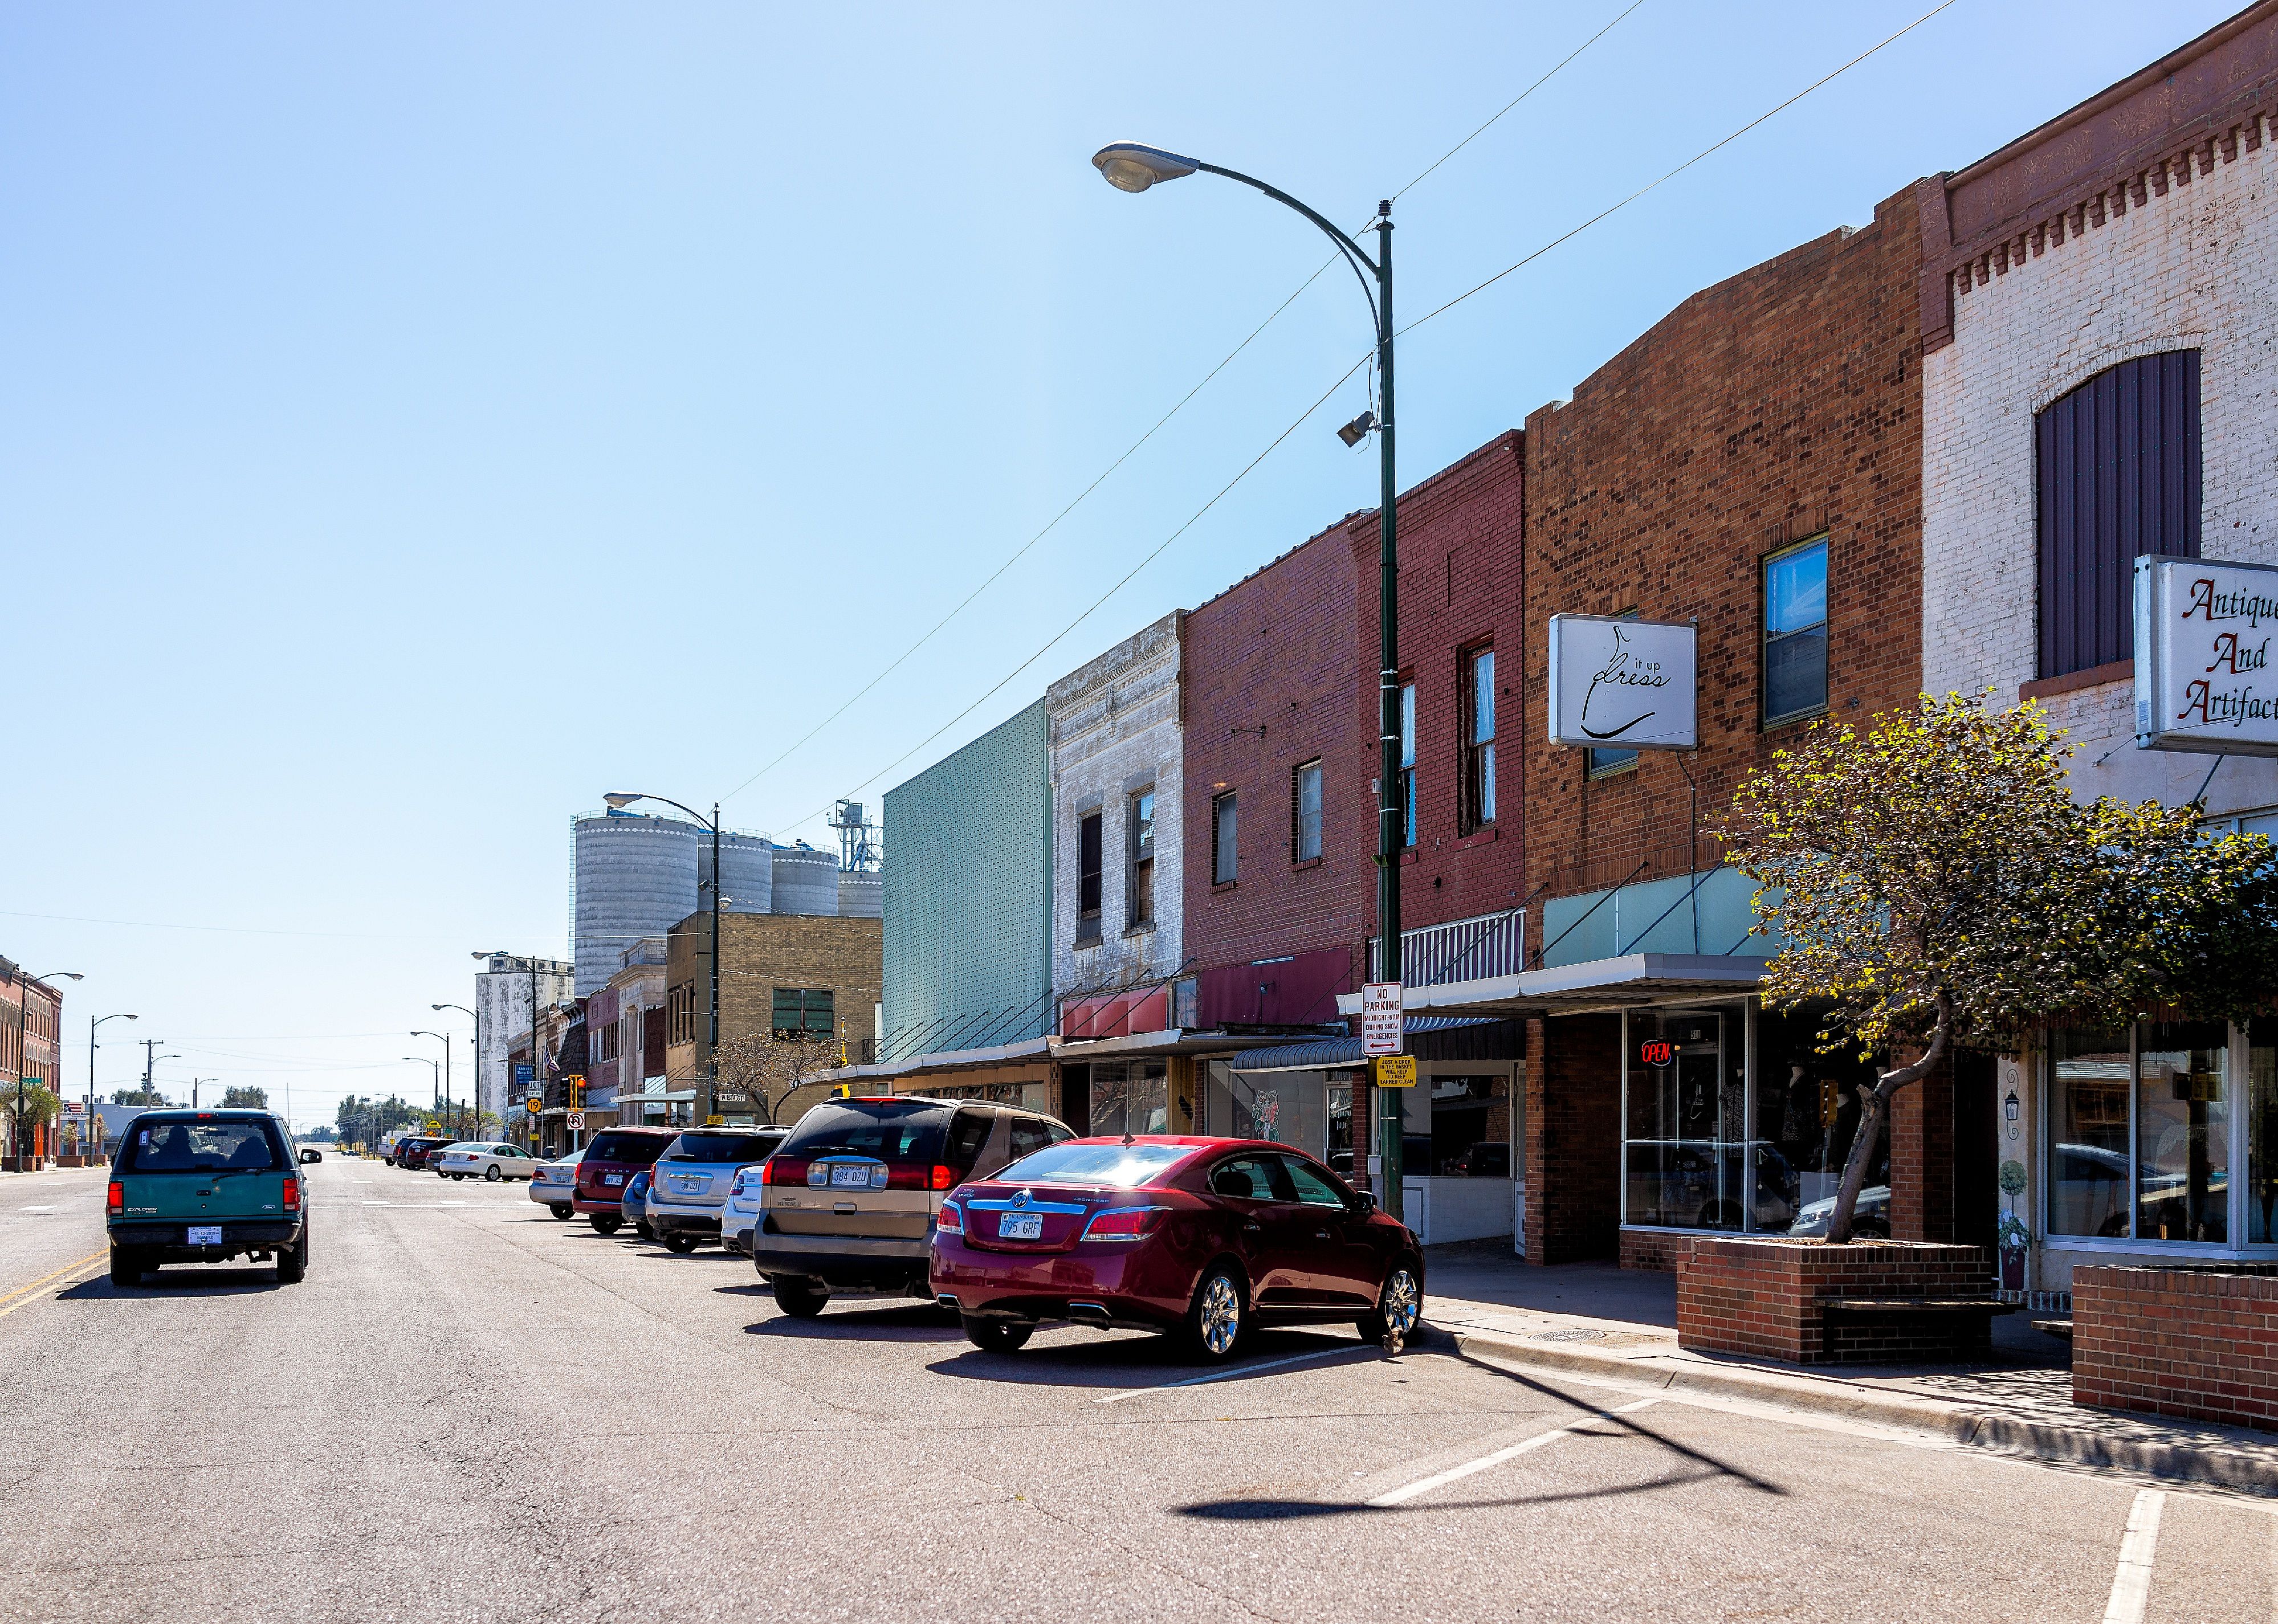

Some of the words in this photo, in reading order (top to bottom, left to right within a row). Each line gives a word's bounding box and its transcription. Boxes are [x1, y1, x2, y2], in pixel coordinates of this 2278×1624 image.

[2206, 633, 2271, 674] And
[1593, 652, 1671, 687] dress
[1635, 658, 1642, 669] it
[1647, 662, 1660, 674] up
[1377, 989, 1387, 999] NO
[1364, 1001, 1399, 1012] PARKING
[1643, 1043, 1670, 1062] OPEN
[834, 1172, 848, 1182] 384
[851, 1172, 866, 1182] DZU
[1003, 1221, 1018, 1233] 795
[1022, 1222, 1040, 1234] GRF
